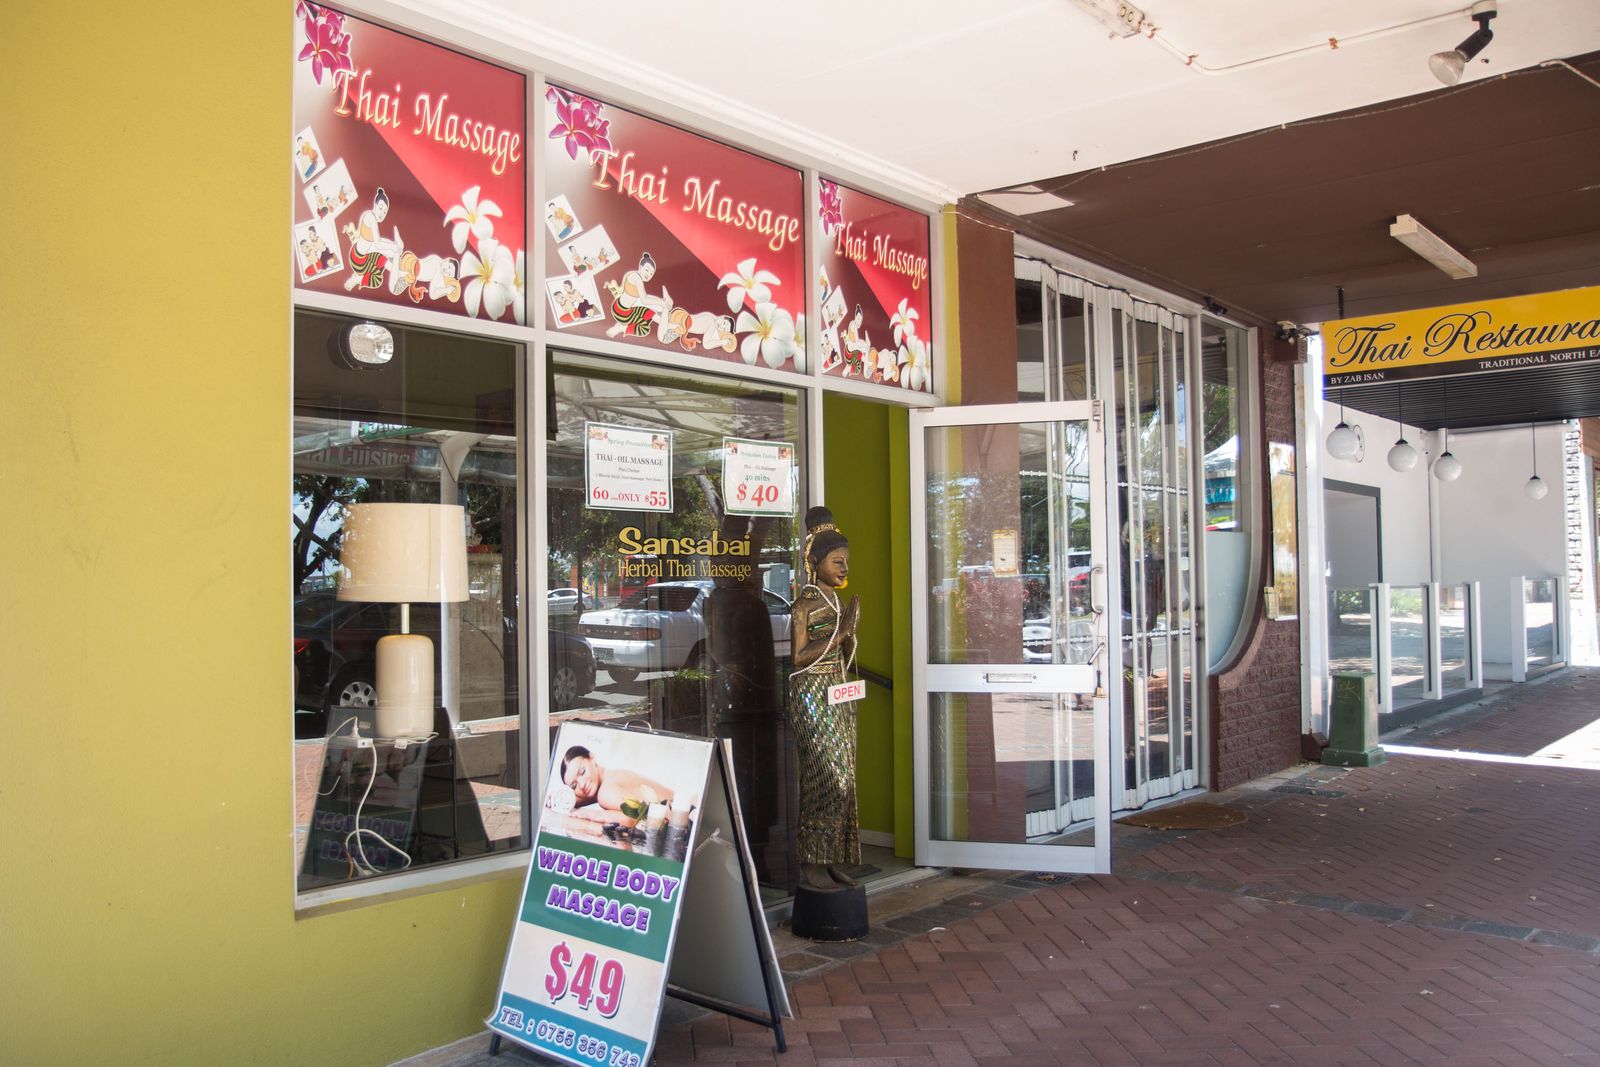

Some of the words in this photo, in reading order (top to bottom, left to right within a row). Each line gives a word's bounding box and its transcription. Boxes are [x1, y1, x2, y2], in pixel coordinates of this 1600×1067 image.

[331, 66, 402, 127] Thai
[413, 93, 522, 175] Massage
[588, 148, 670, 205] Thai
[683, 177, 800, 252] Massage
[833, 222, 867, 262] Thai
[872, 235, 929, 281] Massage
[1329, 323, 1412, 367] Thai
[1478, 354, 1547, 369] TRADITIONAL
[1550, 350, 1586, 362] NORTH
[1330, 376, 1342, 385] BY
[1344, 374, 1362, 383] ZAB
[1363, 372, 1385, 381] ISAN
[617, 455, 629, 463] OIL
[630, 456, 664, 466] MASSAGE
[745, 474, 753, 482] 40
[754, 473, 770, 482] mins
[592, 486, 609, 500] 60
[618, 492, 641, 502] ONLY
[618, 526, 751, 557] Sansabai
[617, 559, 662, 577] Herbal
[667, 559, 696, 577] Thai
[700, 560, 752, 581] Massage
[833, 684, 861, 700] OPEN
[537, 846, 611, 885] WHOLE
[613, 865, 680, 902] BODY
[546, 885, 652, 935] MASSAGE
[544, 941, 627, 1019] $49
[500, 1007, 524, 1029] TEL
[537, 1020, 576, 1048] 0755
[577, 1034, 609, 1061] 356
